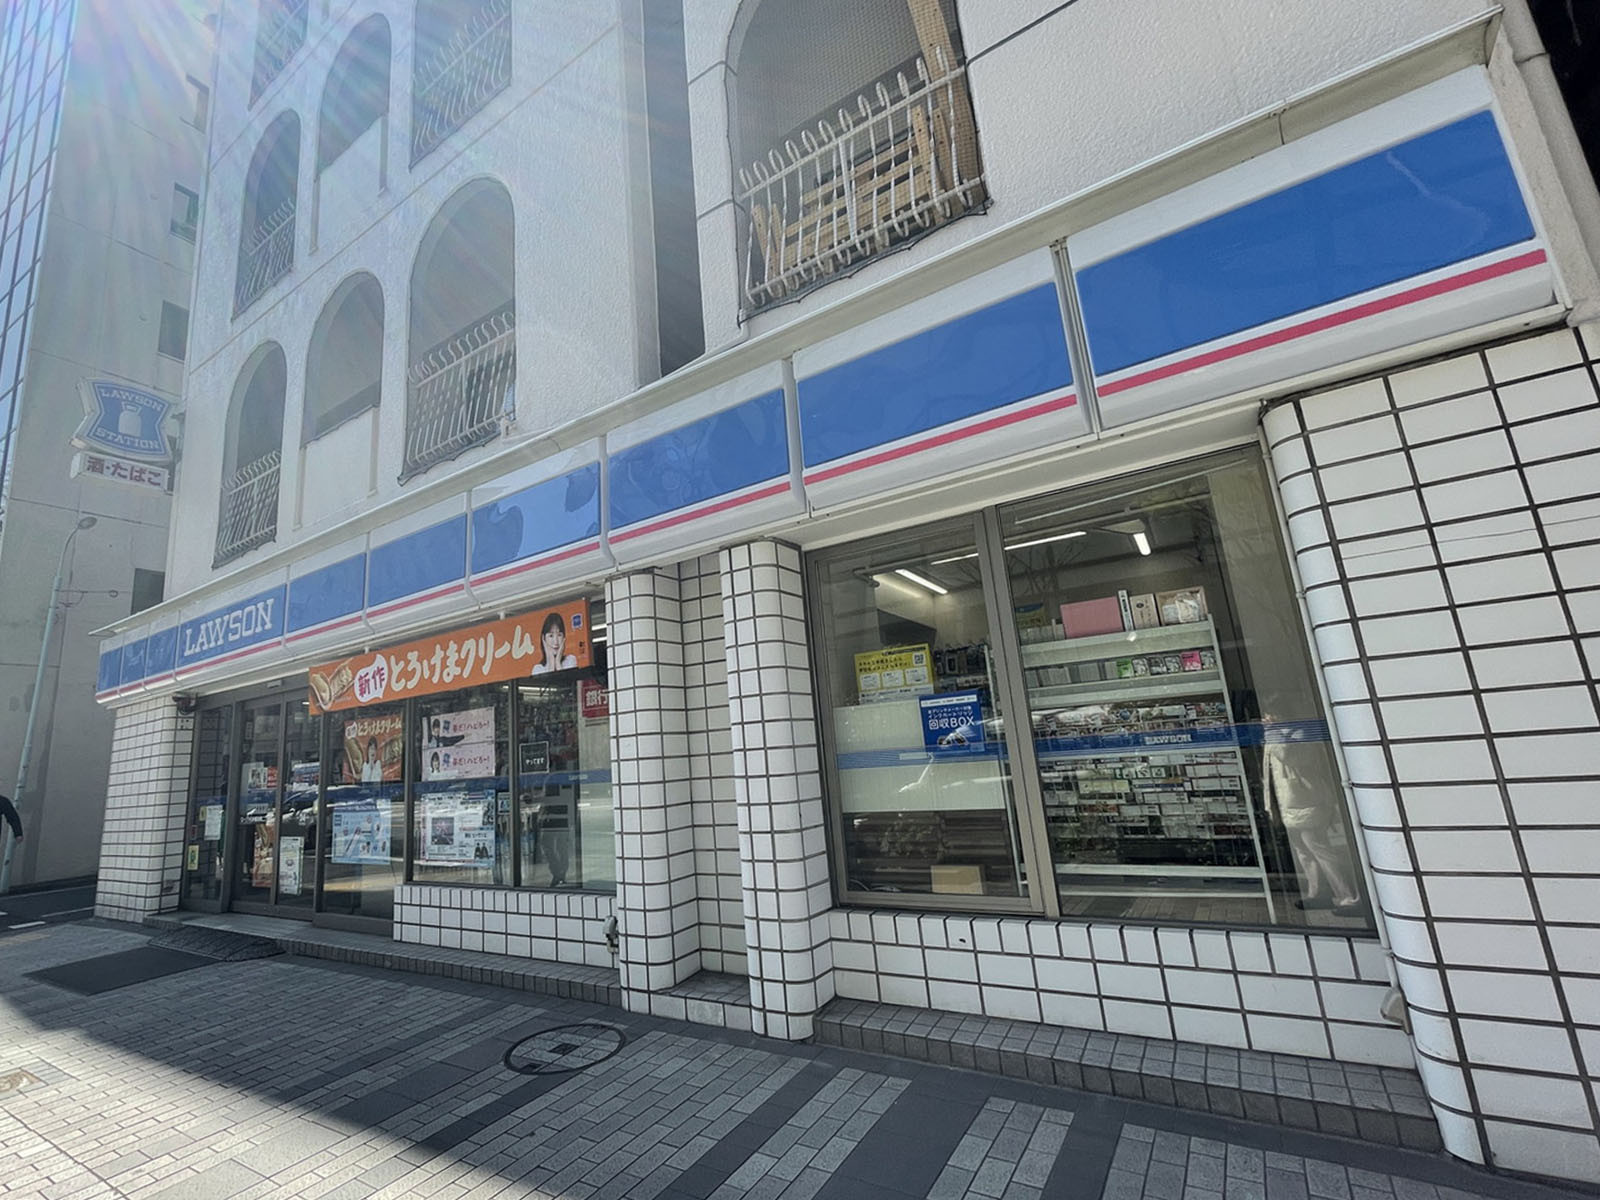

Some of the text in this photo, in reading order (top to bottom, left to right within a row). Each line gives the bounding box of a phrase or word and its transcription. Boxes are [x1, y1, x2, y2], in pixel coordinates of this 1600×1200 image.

[99, 388, 163, 412] LAWSON
[95, 426, 159, 449] STATION
[86, 455, 162, 486] 酒・たばこ
[183, 598, 275, 657] LAWSON
[358, 624, 535, 698] 新作 とろけまクリーム
[928, 715, 975, 730] 回収BOX
